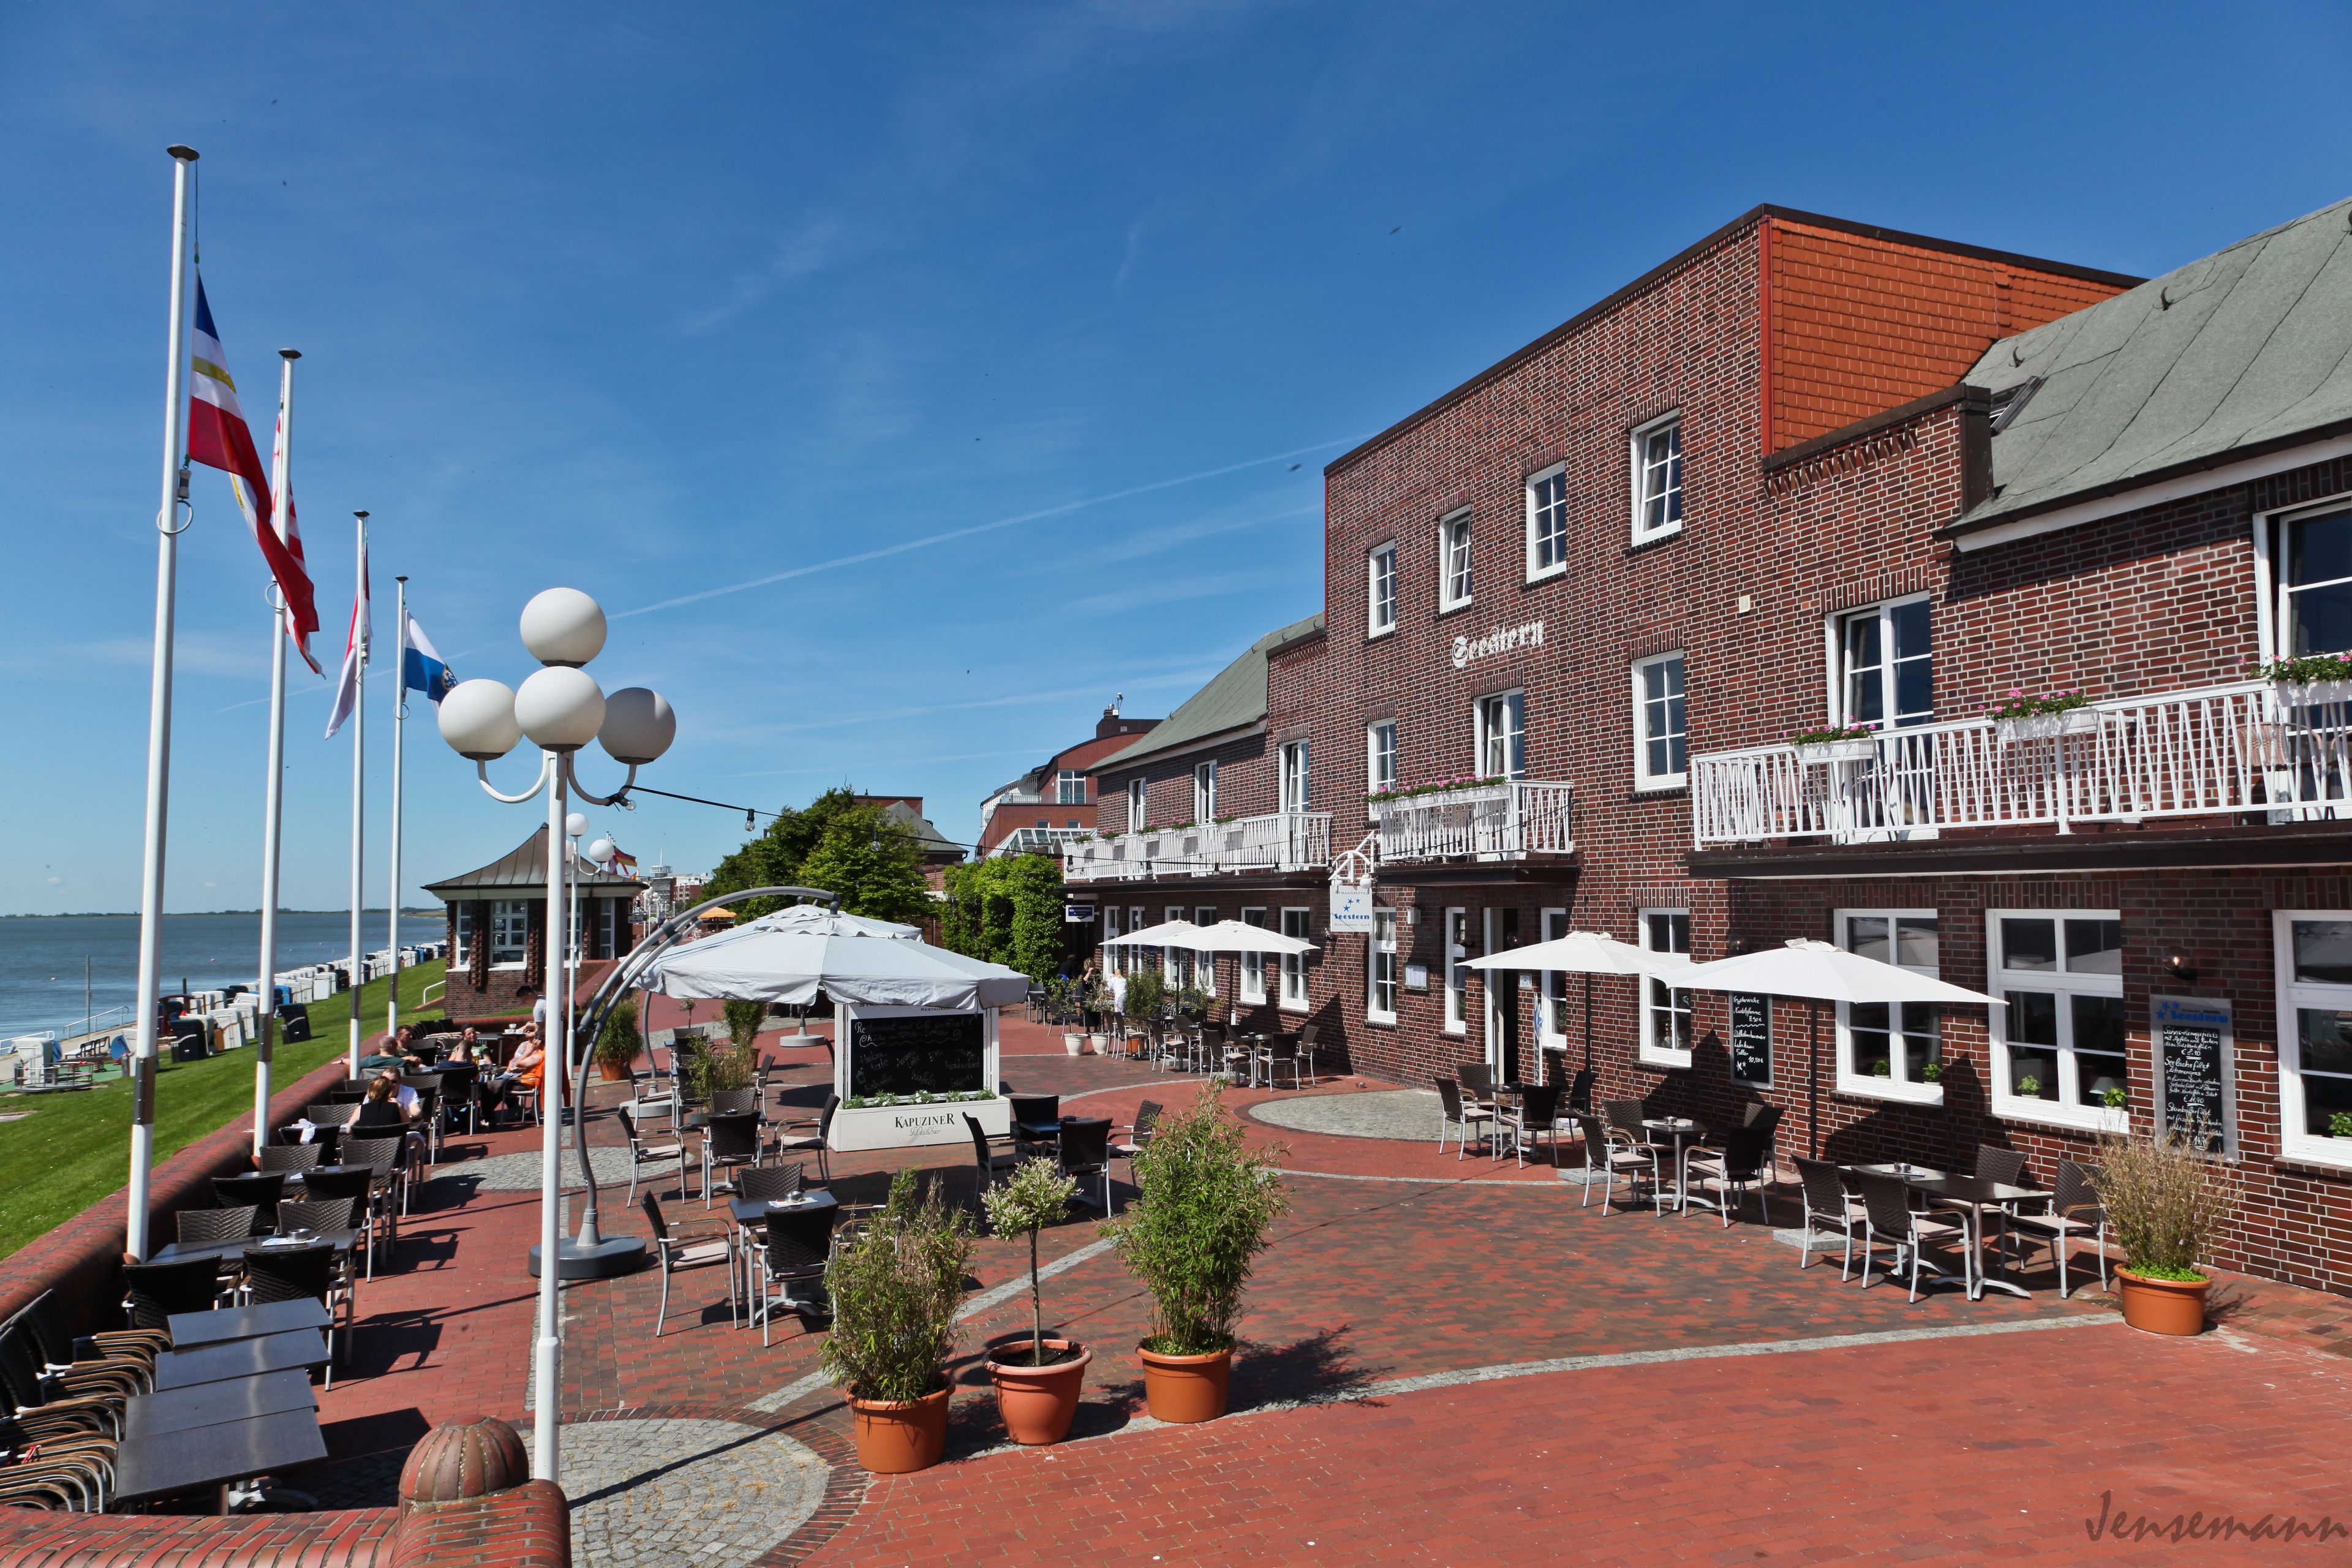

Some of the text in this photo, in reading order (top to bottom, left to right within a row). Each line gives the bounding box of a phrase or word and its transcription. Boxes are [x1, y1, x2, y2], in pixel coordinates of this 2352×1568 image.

[1452, 619, 1544, 668] Seestern
[2170, 1010, 2228, 1023] Seestern
[894, 1113, 955, 1128] KAPUZINER
